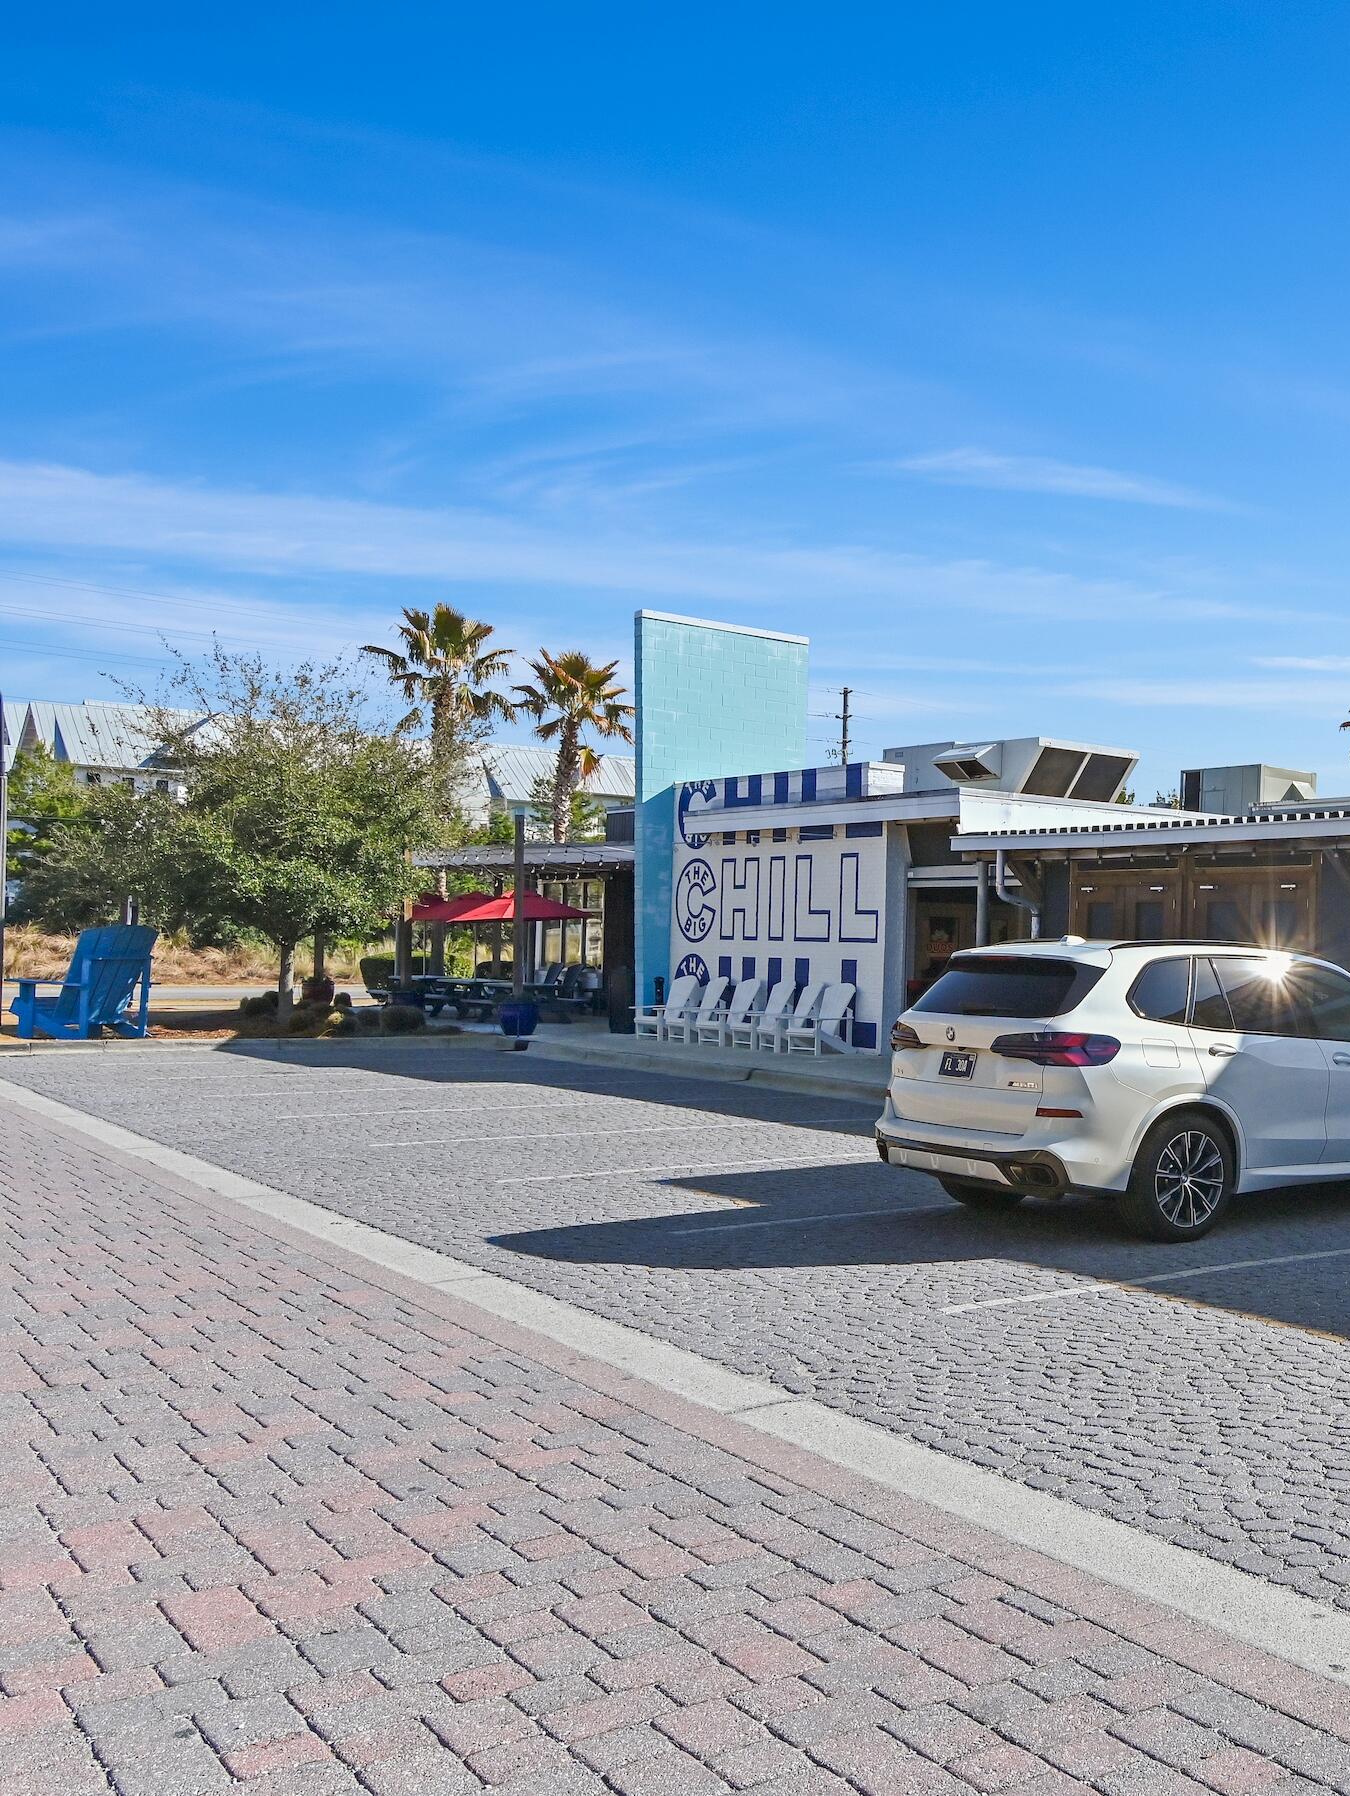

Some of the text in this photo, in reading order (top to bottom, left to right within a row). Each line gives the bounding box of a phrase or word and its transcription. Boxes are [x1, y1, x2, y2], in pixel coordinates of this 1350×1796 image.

[685, 866, 709, 886] THE
[676, 853, 878, 943] CHILL
[684, 916, 706, 936] BIG
[680, 957, 705, 980] THE
